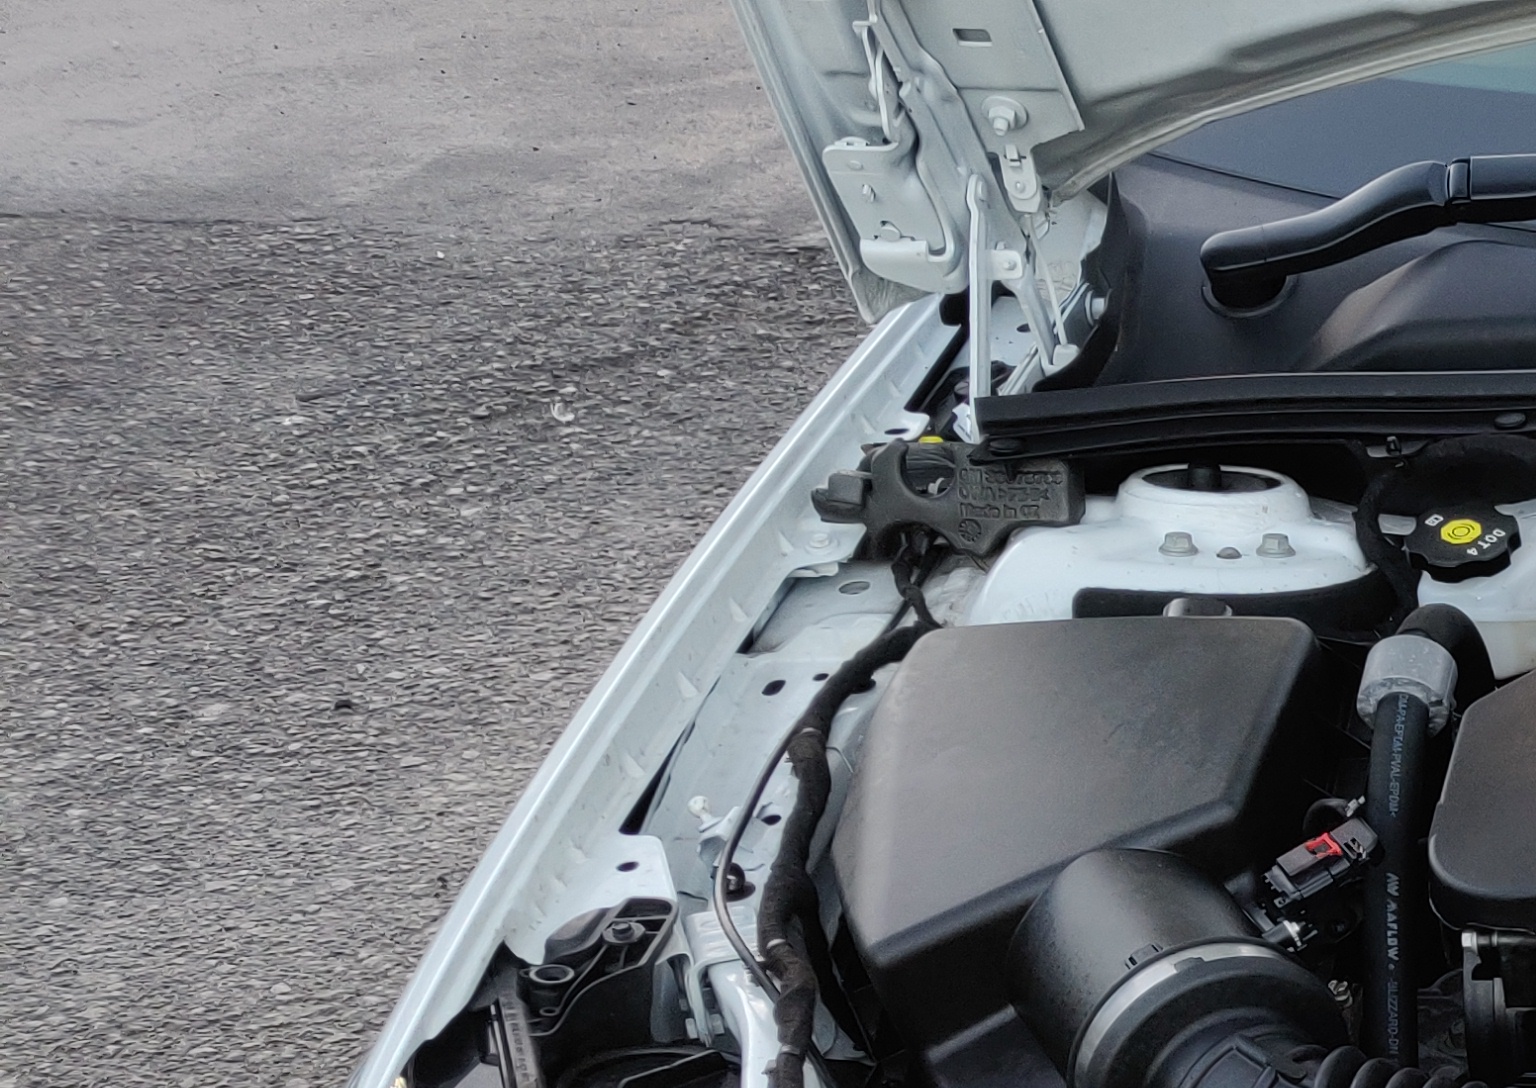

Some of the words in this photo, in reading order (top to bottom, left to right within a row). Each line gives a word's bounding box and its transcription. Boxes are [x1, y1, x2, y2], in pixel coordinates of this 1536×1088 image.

[1477, 527, 1506, 550] DOT
[1466, 547, 1478, 556] 4
[1386, 899, 1399, 961] MAFLOW
